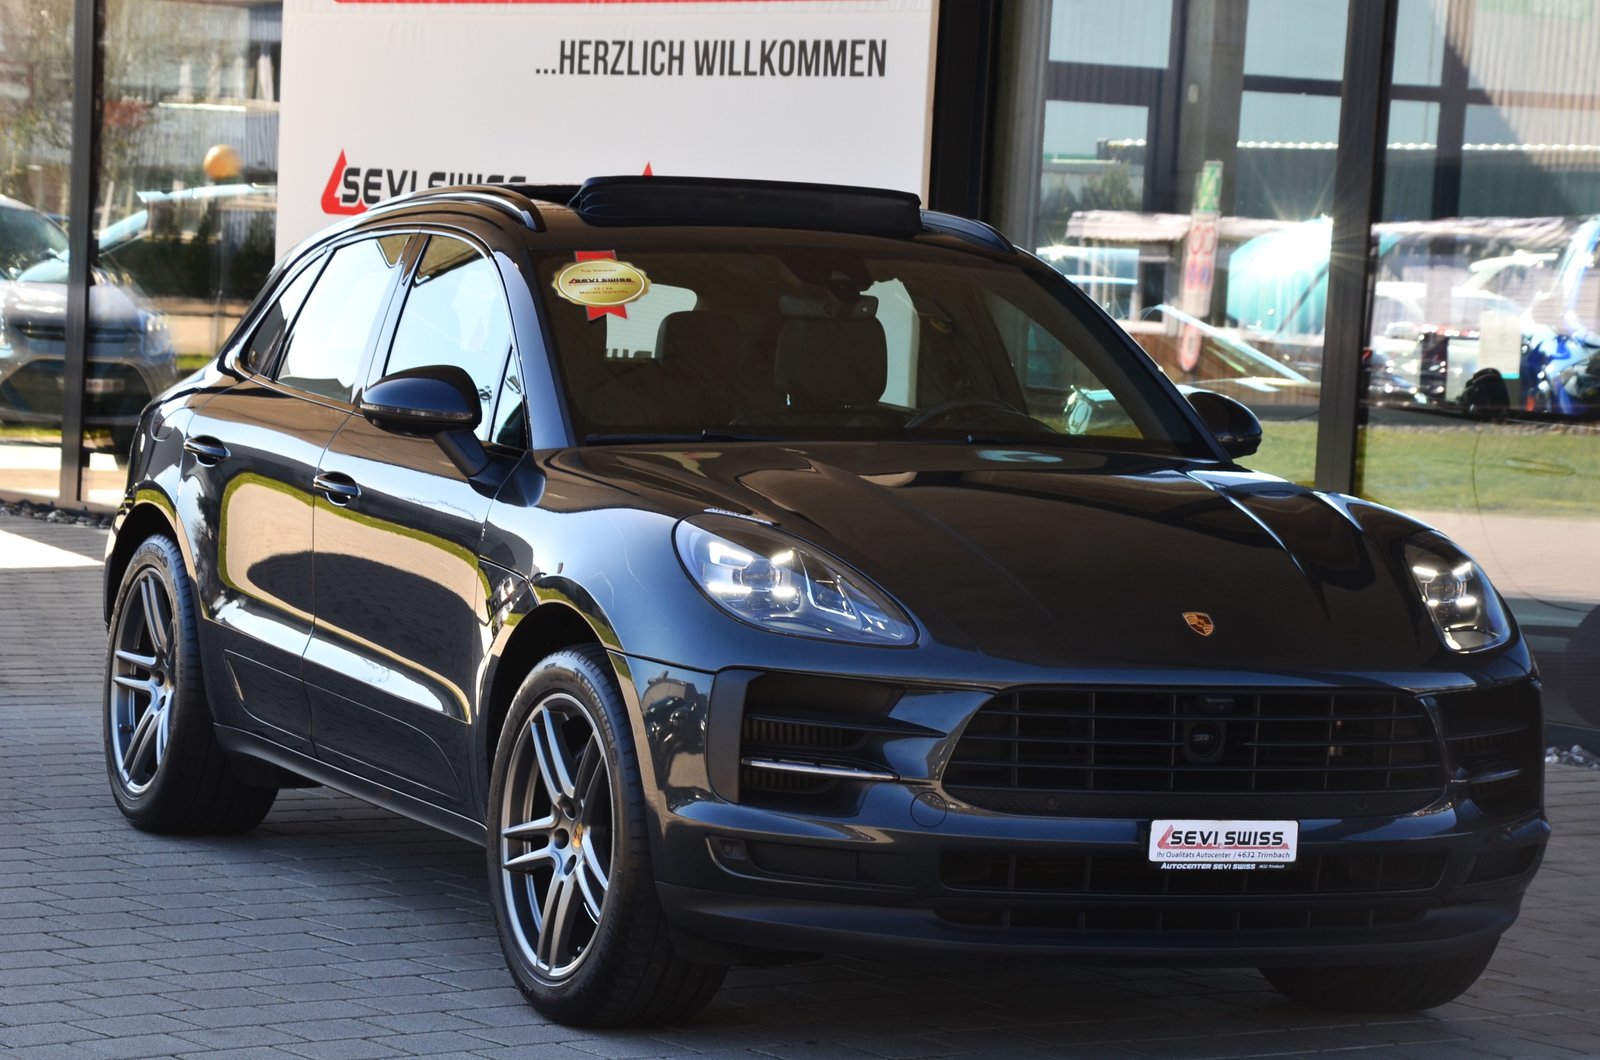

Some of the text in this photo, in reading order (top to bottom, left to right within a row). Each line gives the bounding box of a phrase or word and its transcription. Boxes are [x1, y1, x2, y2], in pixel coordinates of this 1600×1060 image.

[694, 39, 888, 78] WILLKOMMEN
[341, 166, 419, 205] SEVI
[1170, 830, 1284, 846] SEVI SWISS
[1195, 851, 1232, 859] Autocenter
[1237, 851, 1255, 859] 4632
[1257, 851, 1291, 859] Trimbach
